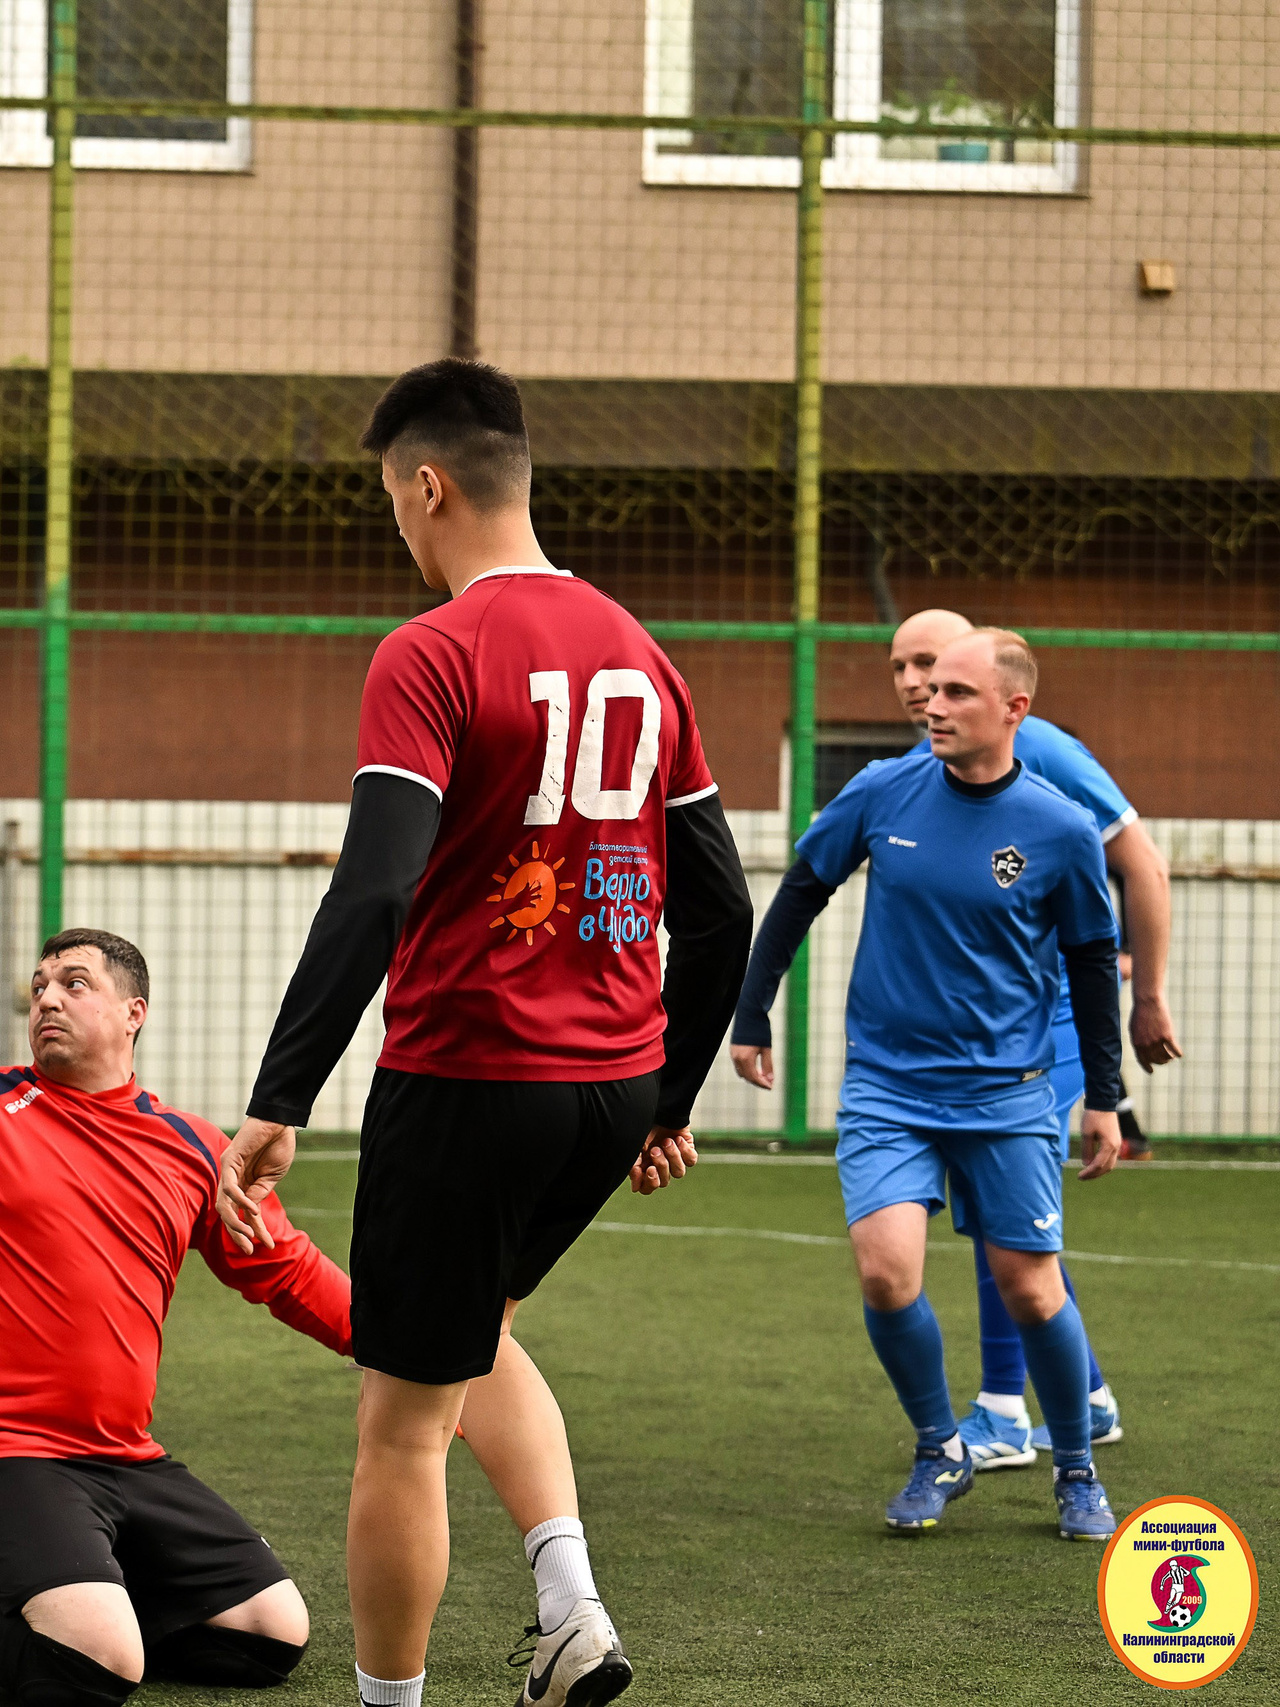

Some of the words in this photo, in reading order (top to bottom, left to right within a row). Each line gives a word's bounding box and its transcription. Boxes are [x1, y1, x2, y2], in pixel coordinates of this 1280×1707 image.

[523, 668, 662, 826] 10
[583, 858, 651, 910] Верю
[996, 859, 1019, 876] FC
[578, 914, 596, 942] в
[598, 904, 650, 954] Чудо
